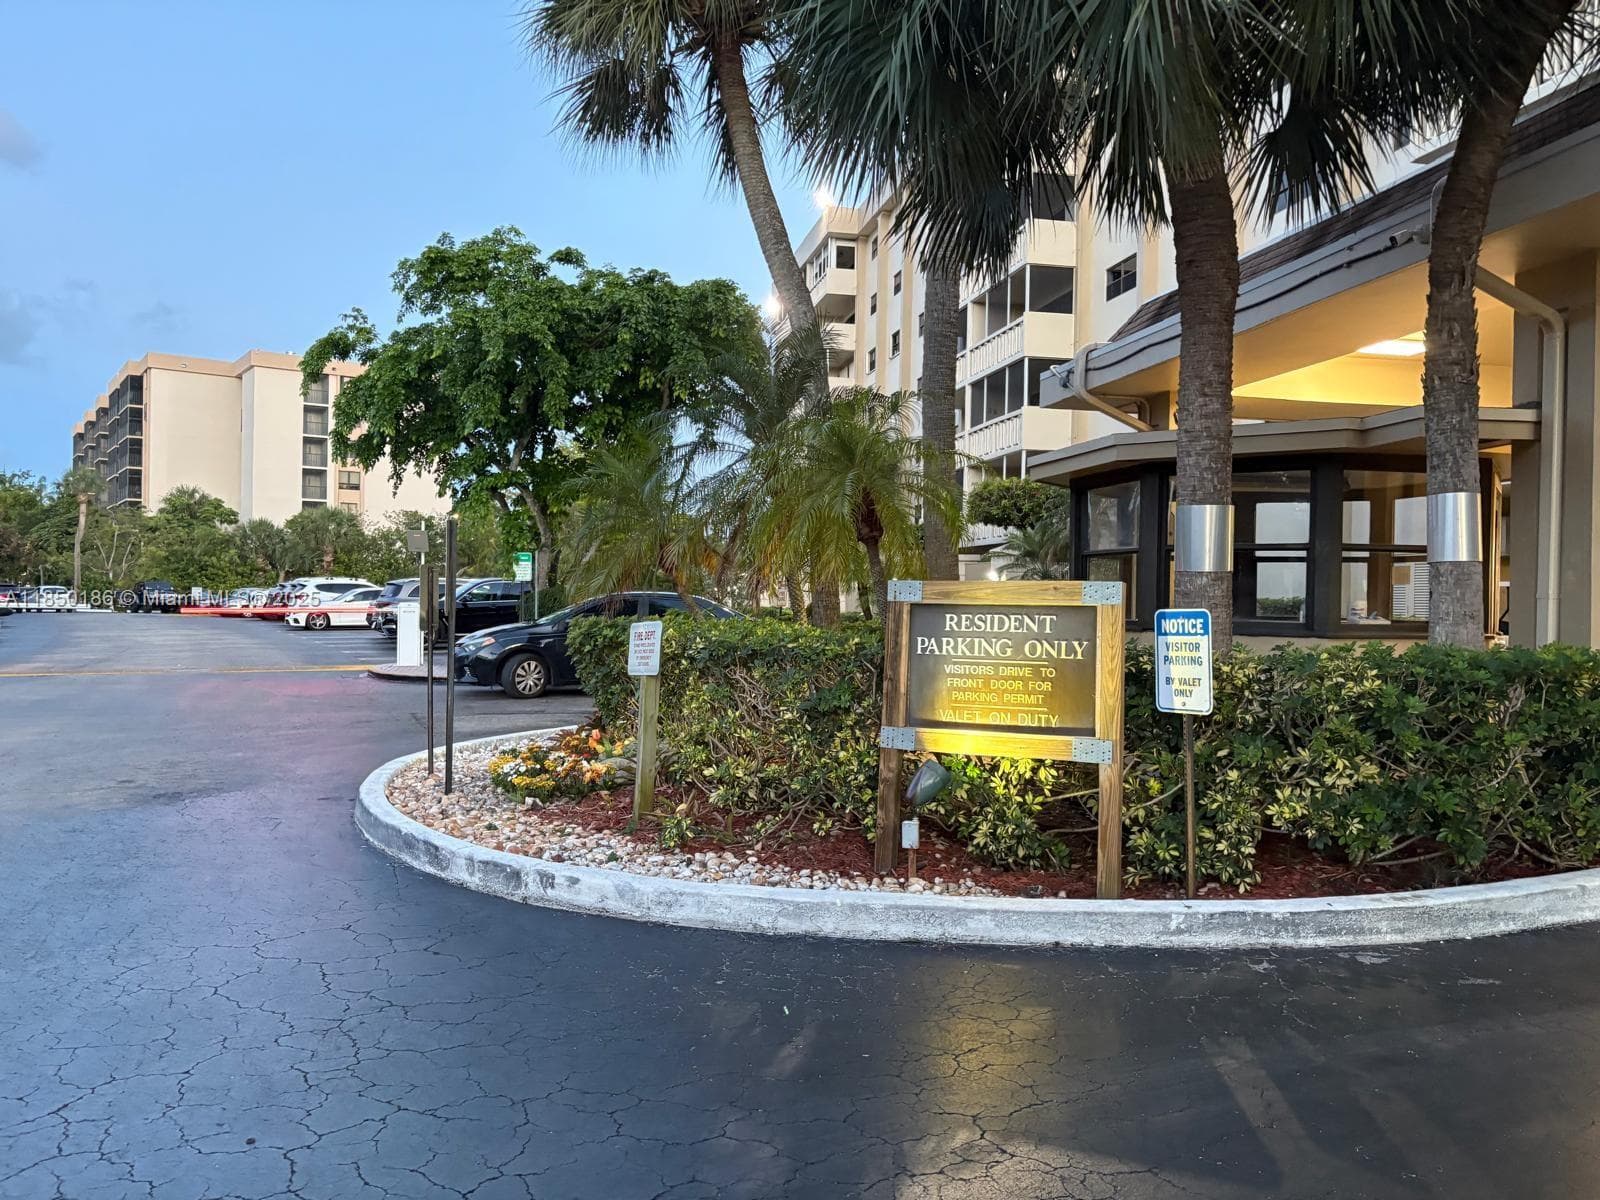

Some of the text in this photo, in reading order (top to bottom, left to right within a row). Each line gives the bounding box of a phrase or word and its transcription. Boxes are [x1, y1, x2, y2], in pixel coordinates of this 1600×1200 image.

[944, 614, 1057, 634] RESIDENT
[1161, 618, 1204, 634] NOTICE
[916, 637, 1088, 660] PARKING ONLY
[1165, 642, 1200, 652] VISITOR
[1163, 655, 1203, 666] PARKING
[944, 664, 1056, 678] VISITORS DRIVE TO
[947, 678, 1052, 691] FRONT DOOR FOR
[1165, 676, 1202, 687] BY VALET
[952, 691, 1044, 705] PARKING PERMIT
[1174, 688, 1193, 698] ONLY
[939, 709, 1059, 728] VALET ON DUTY
